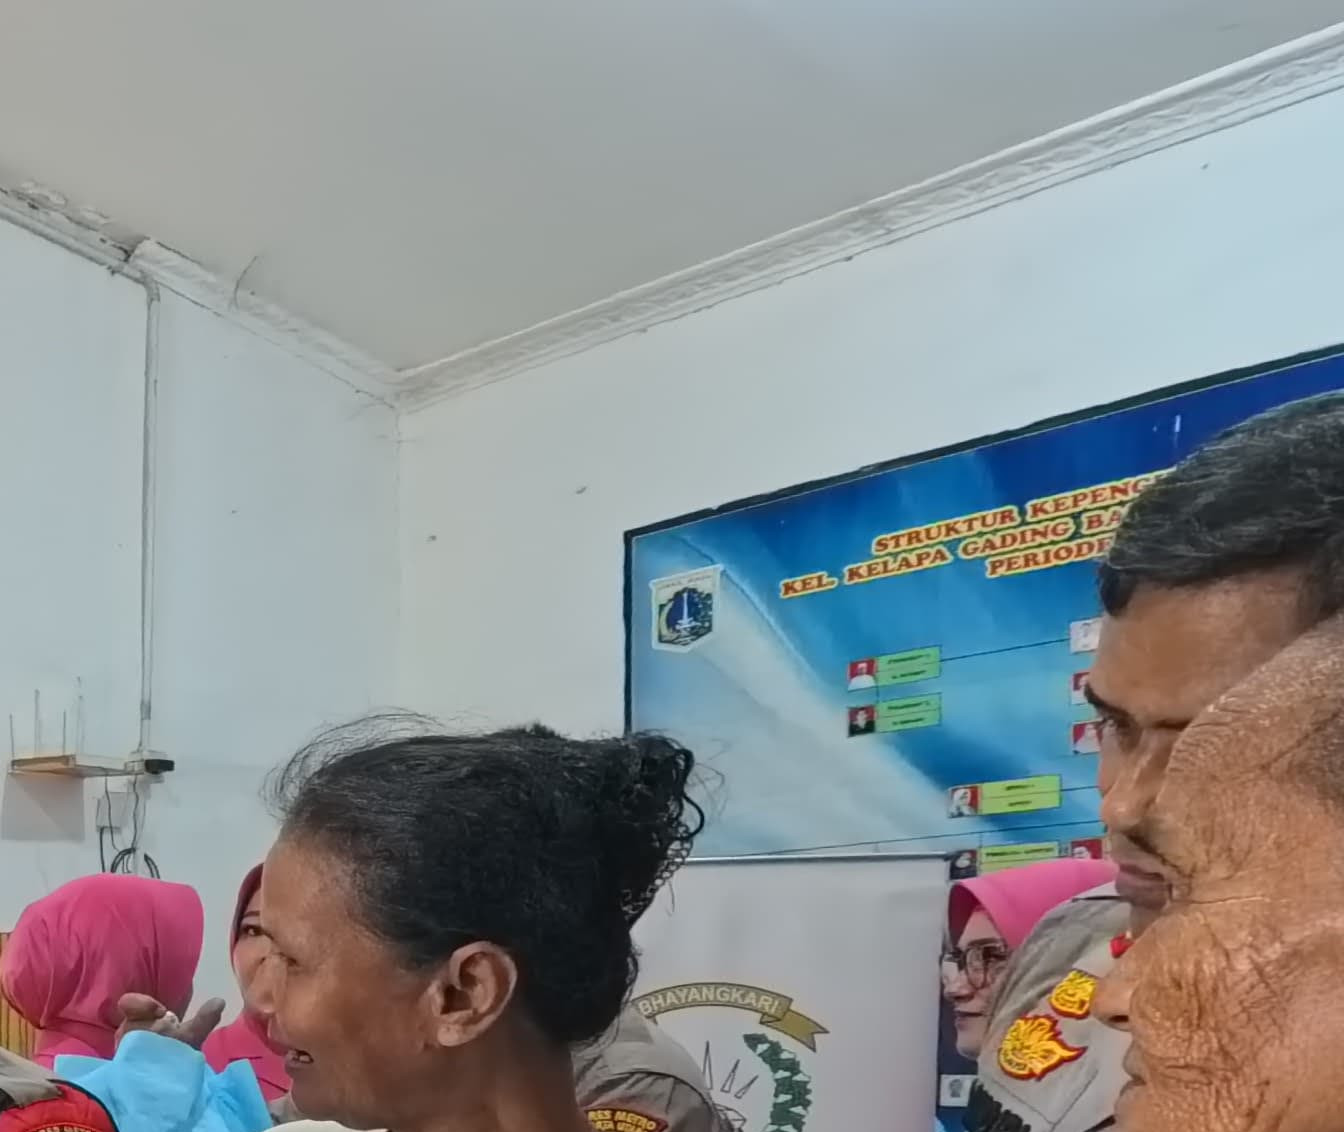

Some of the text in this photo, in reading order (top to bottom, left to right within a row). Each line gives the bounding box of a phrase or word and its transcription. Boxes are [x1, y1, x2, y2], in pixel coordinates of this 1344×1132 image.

[874, 507, 1017, 553] STRUKTUR
[781, 574, 835, 597] KEL.
[846, 550, 950, 583] KELAPA
[962, 520, 1070, 558] GADING
[639, 984, 779, 1017] BHAYANGKARI
